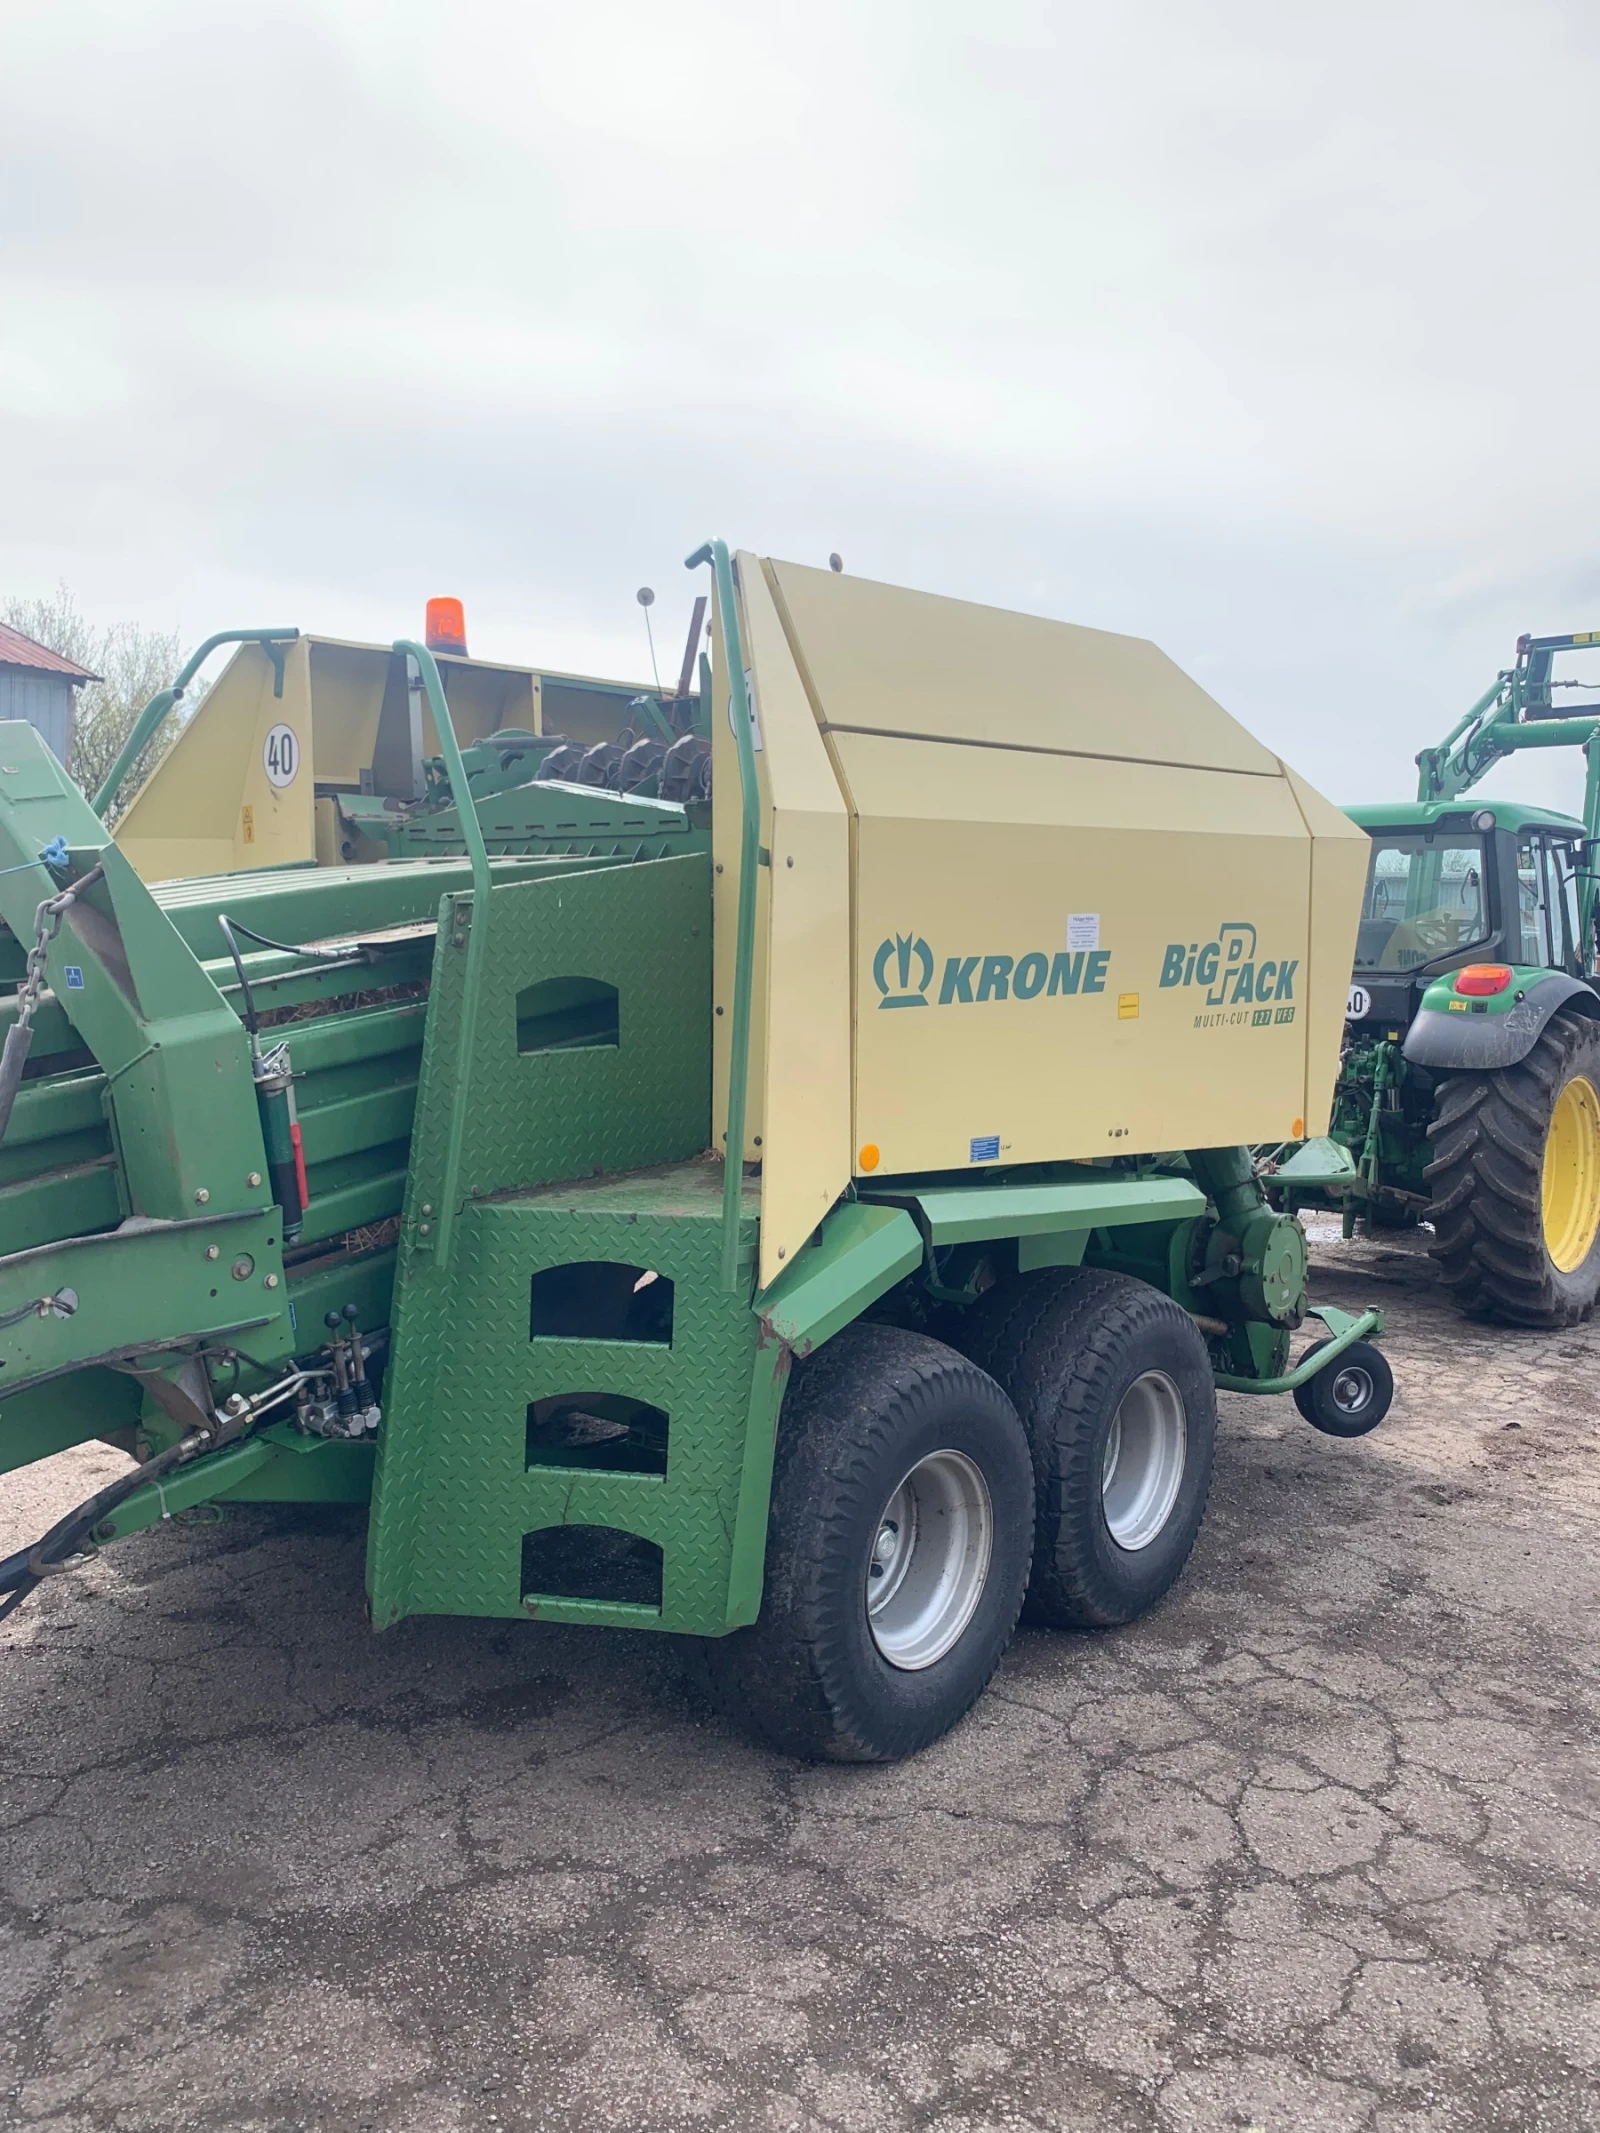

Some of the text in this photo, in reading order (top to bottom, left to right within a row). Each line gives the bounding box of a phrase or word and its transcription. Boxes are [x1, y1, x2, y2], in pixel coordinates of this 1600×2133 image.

[268, 733, 293, 776] 40
[938, 950, 1112, 1005] KRONE
[1193, 1008, 1294, 1029] MULTI-CUT 127 VFS
